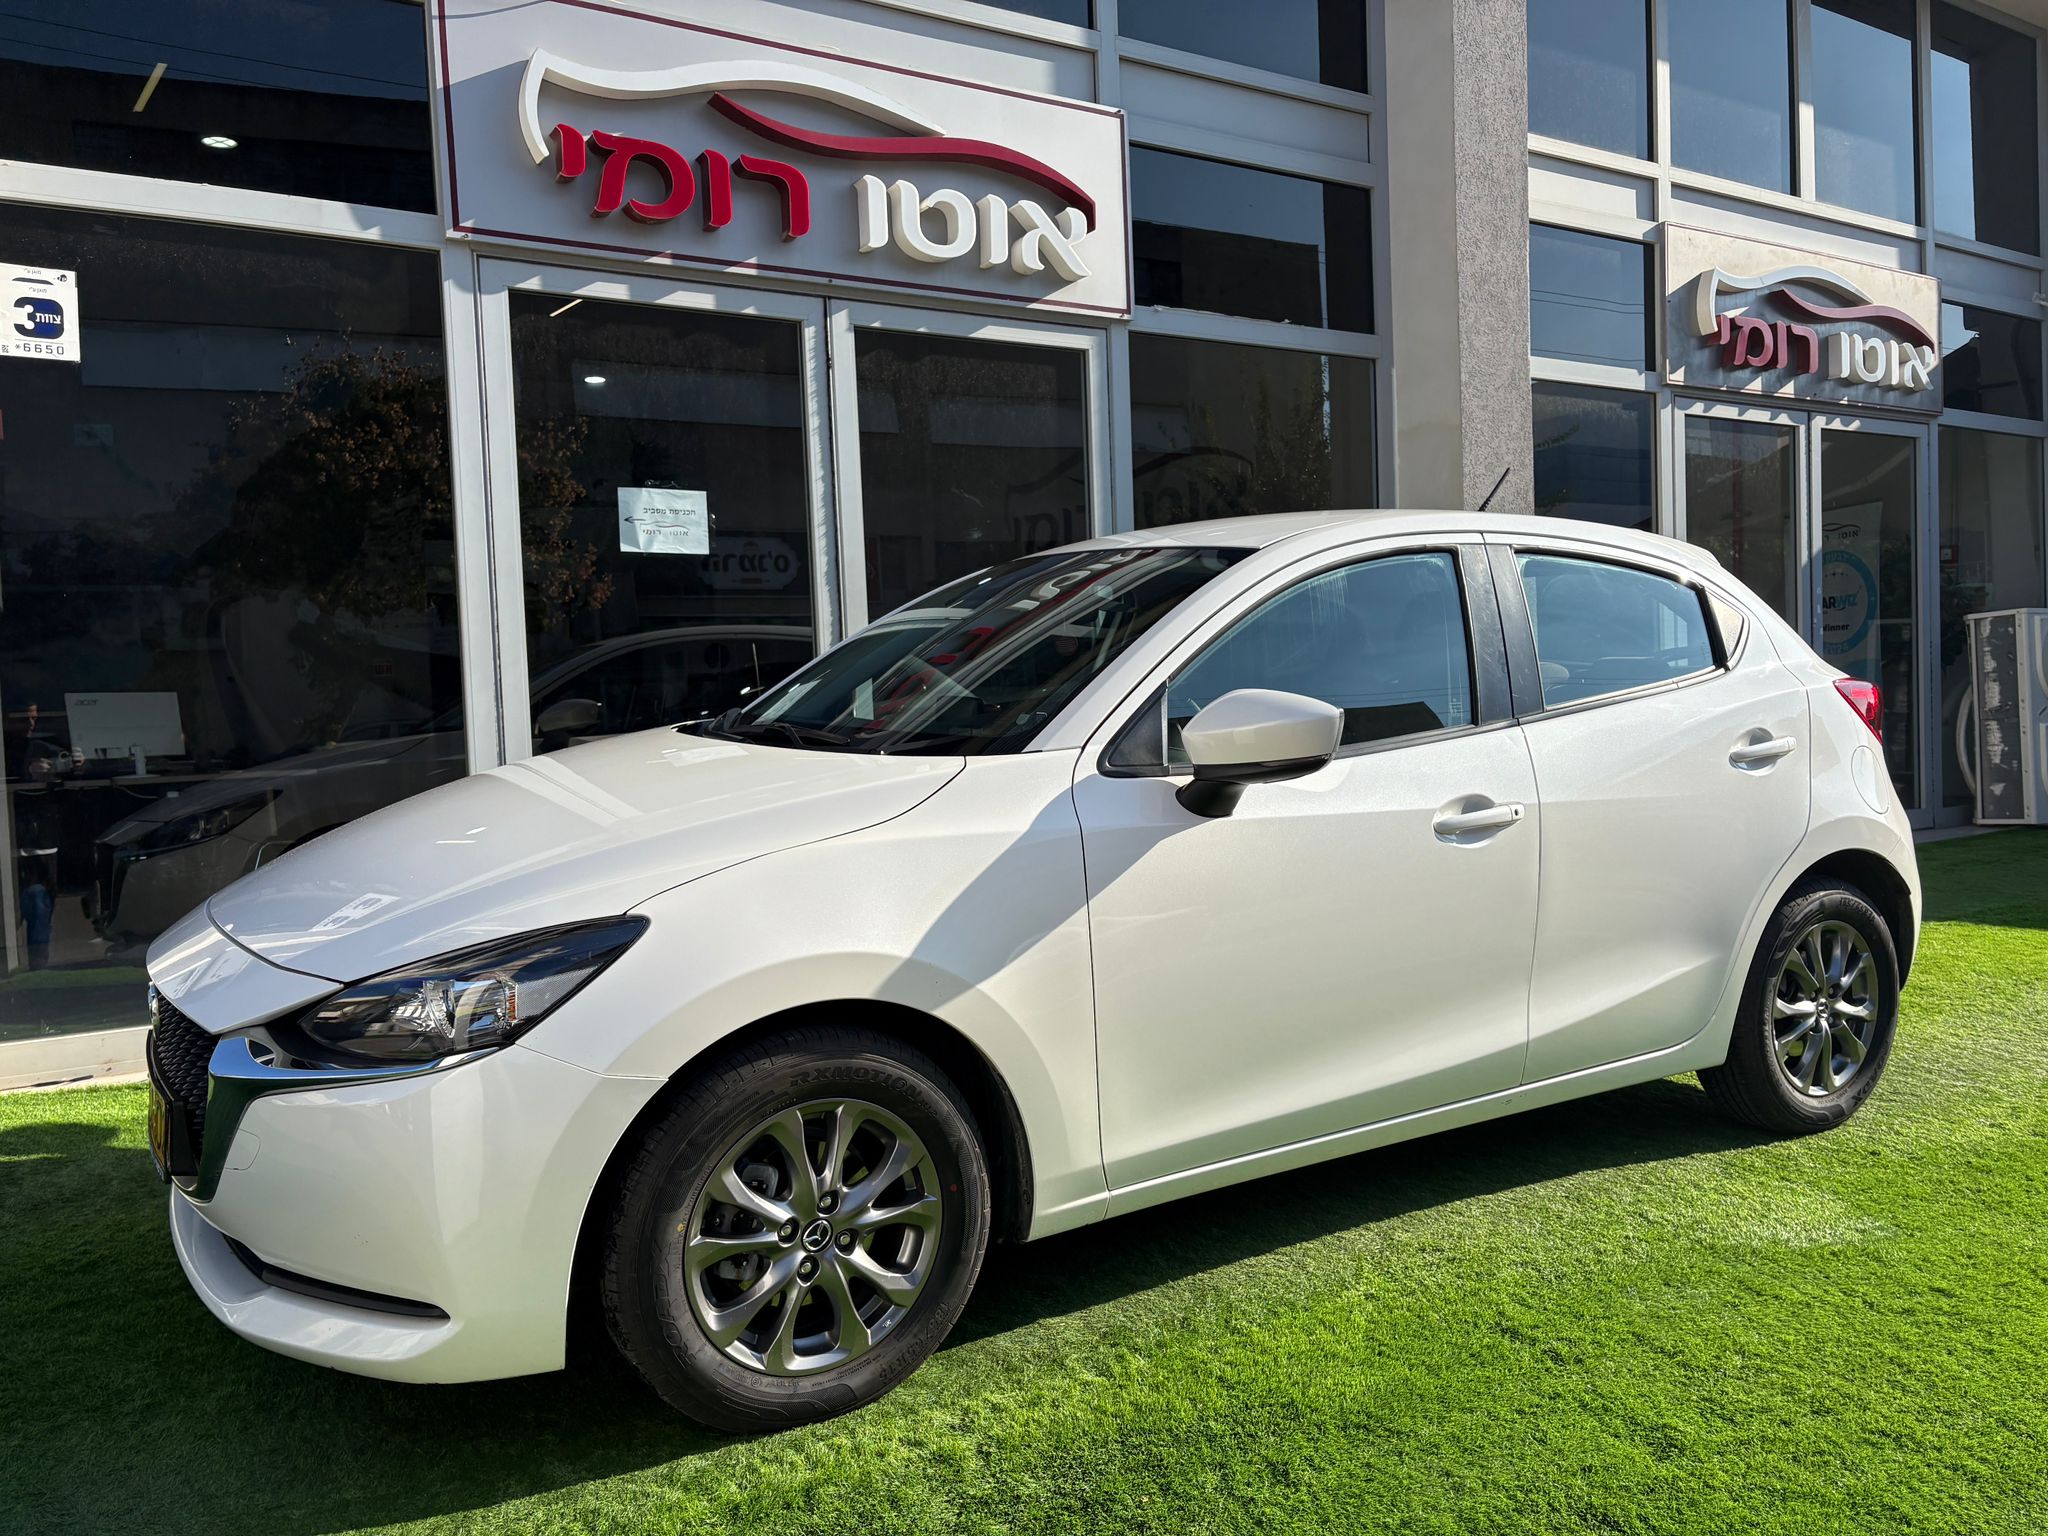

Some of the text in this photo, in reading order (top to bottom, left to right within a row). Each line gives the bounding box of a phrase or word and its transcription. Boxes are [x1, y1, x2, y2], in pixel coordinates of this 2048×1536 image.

[549, 123, 1091, 282] אוטו רומי
[35, 312, 62, 324] צוות
[1706, 314, 1934, 393] אוטו רומי
[642, 506, 667, 516] מסביב
[1823, 592, 1859, 609] ARWIZ
